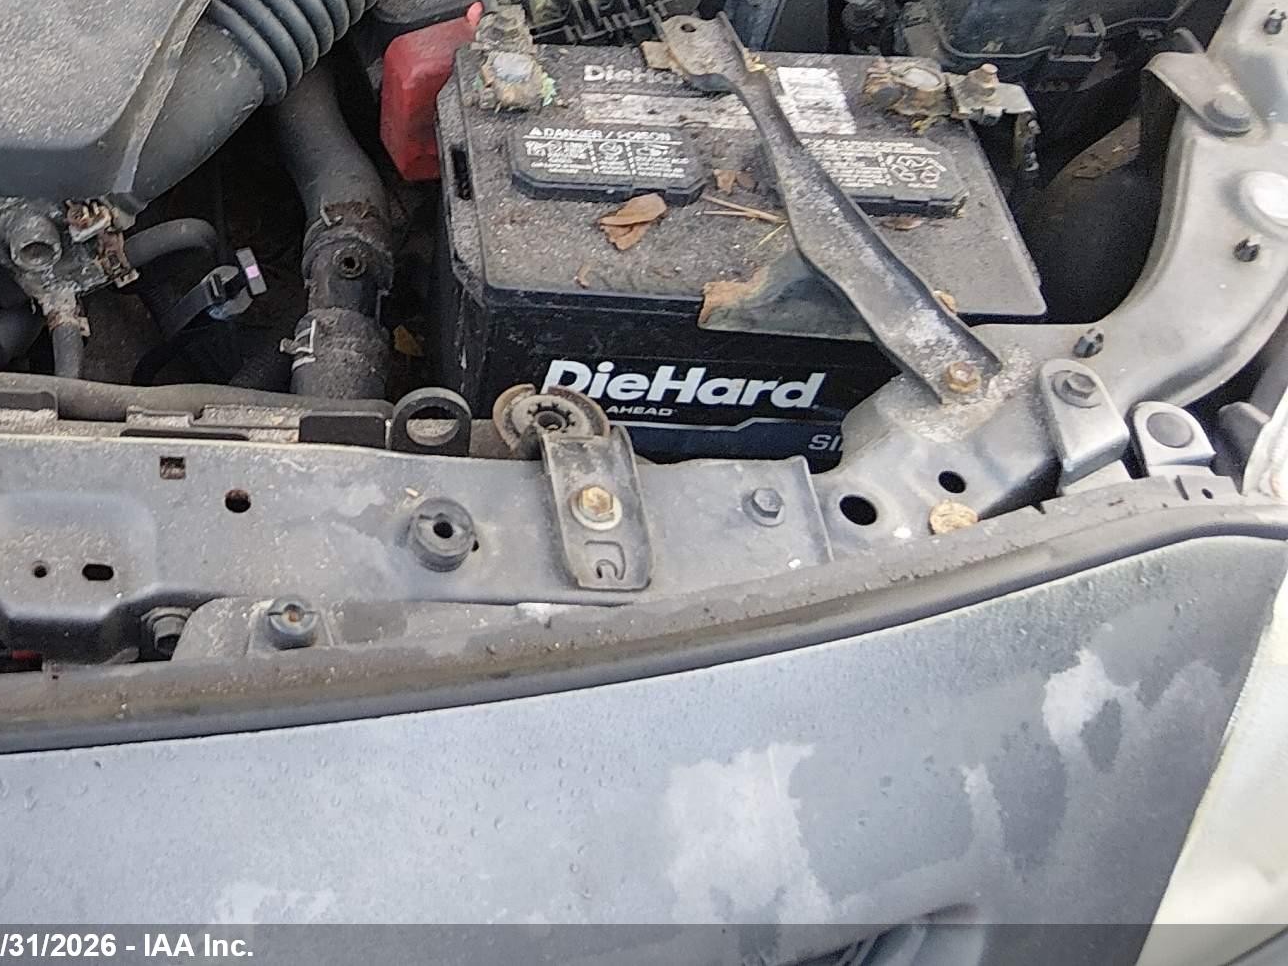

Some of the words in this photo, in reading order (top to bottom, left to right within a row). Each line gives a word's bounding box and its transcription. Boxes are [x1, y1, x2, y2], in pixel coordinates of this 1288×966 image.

[540, 359, 827, 408] DieHard
[605, 405, 674, 417] AHEAD
[807, 433, 842, 452] SI
